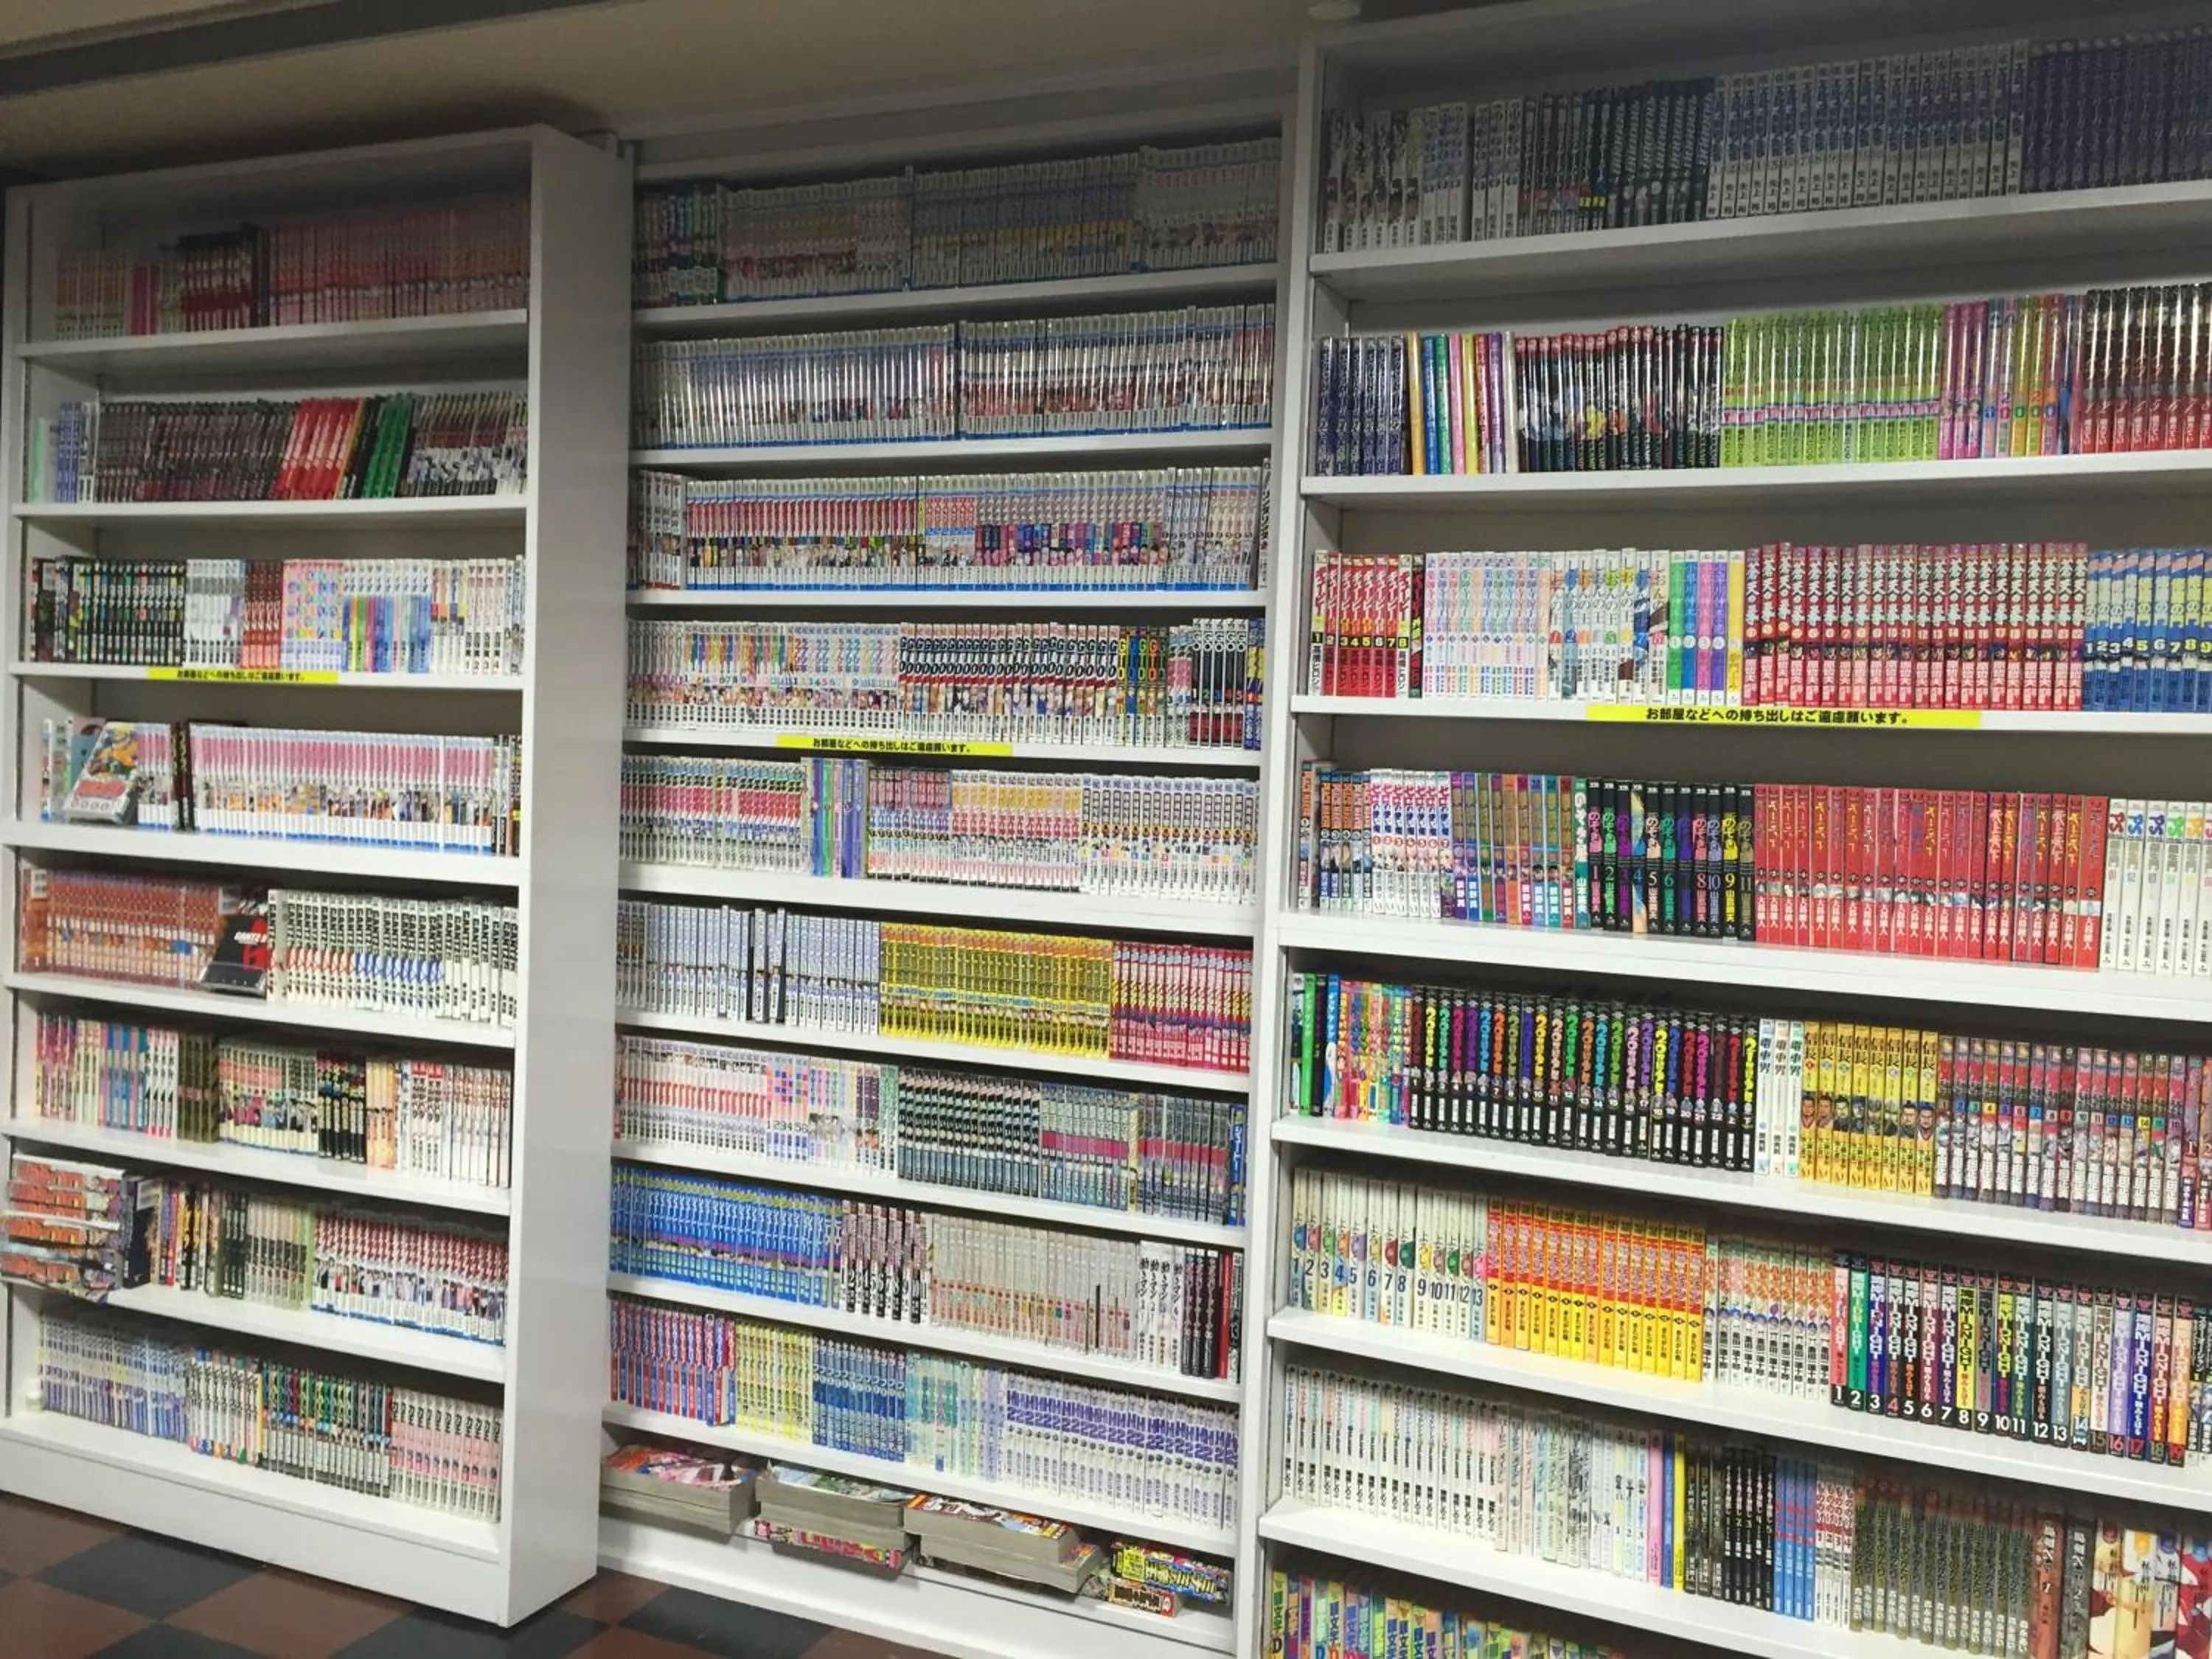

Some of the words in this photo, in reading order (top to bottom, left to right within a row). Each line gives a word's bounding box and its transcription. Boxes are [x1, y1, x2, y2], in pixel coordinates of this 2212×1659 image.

[1315, 633, 1319, 641] 1
[1328, 637, 1334, 645] 2
[1340, 637, 1348, 645] 3
[1363, 638, 1370, 647] 5
[1376, 638, 1382, 646] 6
[1388, 639, 1396, 647] 7
[1399, 639, 1406, 647] 8
[2123, 637, 2133, 647] 4
[2086, 643, 2093, 653] 1
[2097, 641, 2108, 651] 2
[2110, 643, 2121, 653] 3
[2137, 640, 2148, 651] 5
[2154, 639, 2166, 650] 6
[2170, 642, 2180, 653] 7
[2185, 639, 2197, 650] 8
[2201, 642, 2212, 653] 9
[1646, 707, 1908, 725] お部屋などへの持ち出しはご遠慮願います。
[1593, 866, 1598, 880] 1
[1606, 867, 1614, 880] 2
[1634, 867, 1643, 879] 4
[1649, 871, 1657, 885] 5
[1665, 873, 1674, 886] 6
[1697, 874, 1706, 888] 8
[1708, 875, 1720, 888] 10
[1725, 874, 1734, 888] 9
[1741, 877, 1752, 891] 11
[1294, 1259, 1298, 1273] 1
[1306, 1260, 1314, 1276] 2
[1321, 1262, 1329, 1279] 3
[1335, 1265, 1343, 1281] 4
[1349, 1267, 1357, 1284] 5
[1368, 1270, 1376, 1286] 6
[1385, 1274, 1393, 1290] 7
[1398, 1276, 1405, 1292] 8
[1418, 1279, 1427, 1295] 9
[1431, 1282, 1442, 1299] 10
[1445, 1284, 1455, 1300] 11
[1460, 1286, 1470, 1304] 12
[1472, 1290, 1483, 1306] 13
[1836, 1388, 1842, 1399] 1
[1851, 1391, 1860, 1404] 2
[1870, 1395, 1880, 1409] 3
[1888, 1398, 1899, 1411] 4
[1904, 1401, 1914, 1415] 5
[1921, 1404, 1932, 1417] 6
[1941, 1406, 1952, 1420] 7
[1959, 1410, 1969, 1423] 8
[1978, 1413, 1988, 1427] 9
[1994, 1415, 2009, 1430] 10
[2013, 1419, 2025, 1433] 11
[2033, 1423, 2048, 1438] 12
[2053, 1425, 2067, 1441] 13
[2110, 1436, 2124, 1450] 16
[2130, 1439, 2143, 1453] 17
